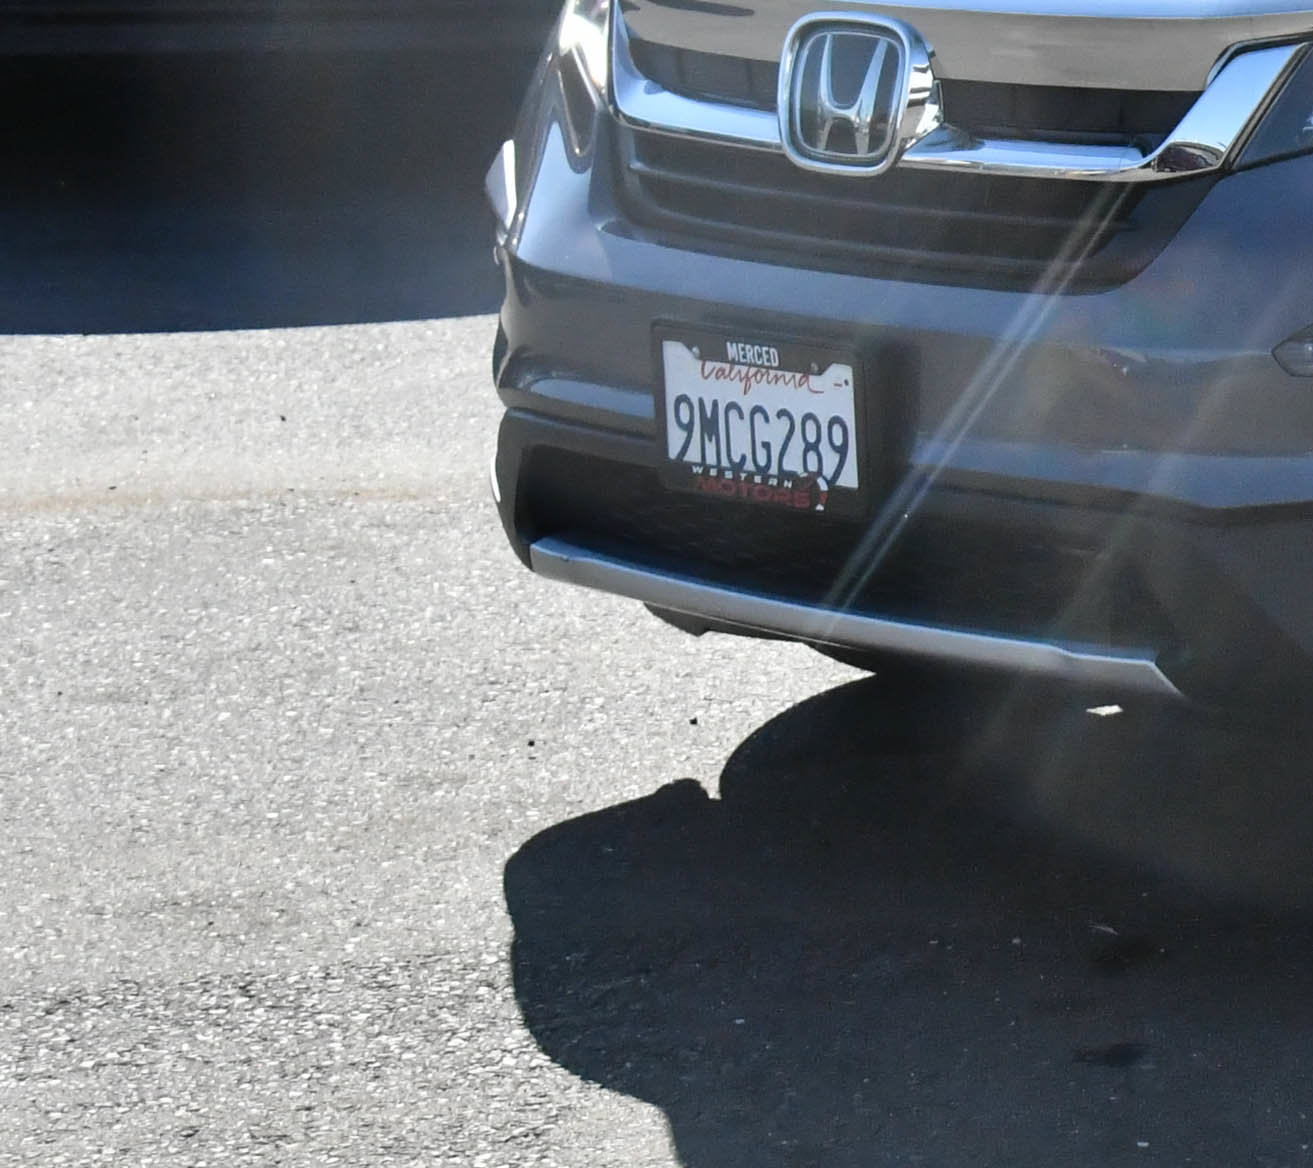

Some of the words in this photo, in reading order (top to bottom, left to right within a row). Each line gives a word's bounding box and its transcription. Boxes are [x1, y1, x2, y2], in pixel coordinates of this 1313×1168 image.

[726, 341, 780, 368] MERCED
[700, 360, 825, 396] California
[672, 393, 850, 485] 9MCG289
[691, 464, 793, 489] WESTERN
